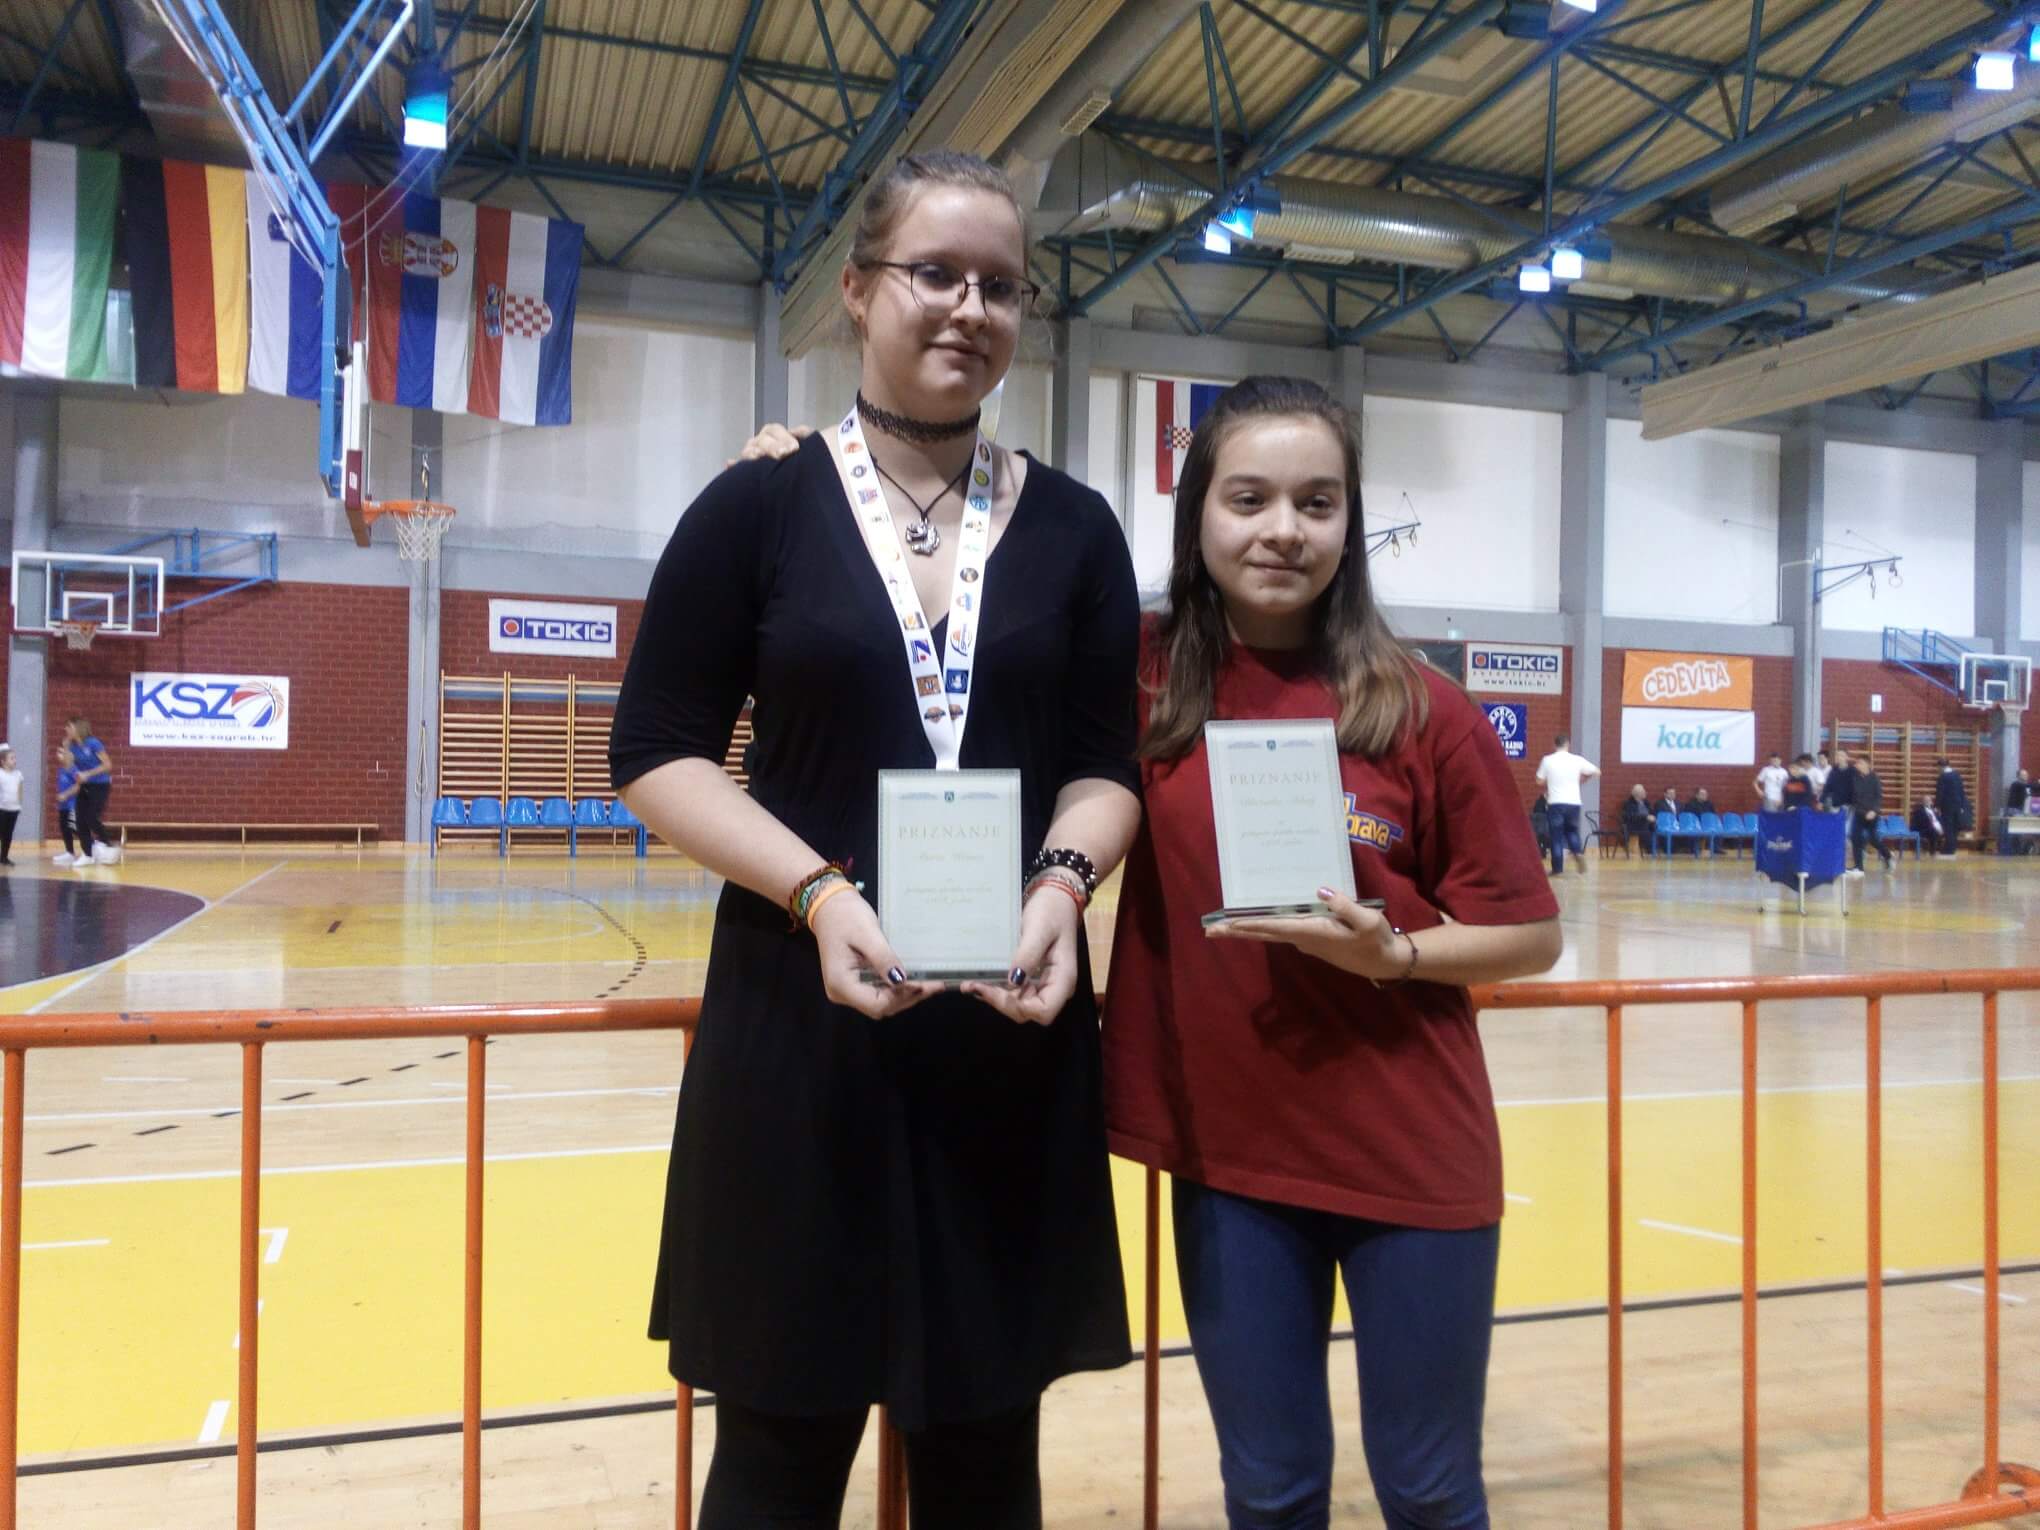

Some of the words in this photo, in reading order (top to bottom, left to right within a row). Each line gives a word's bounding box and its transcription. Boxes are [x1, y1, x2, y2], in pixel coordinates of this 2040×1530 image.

[526, 621, 609, 641] TOKIĆ
[1492, 654, 1556, 671] TOKIĆ
[1644, 661, 1730, 698] CEDEVITA
[135, 679, 241, 720] KSZ
[1656, 724, 1722, 750] kala
[898, 825, 1000, 840] PRIZNANJE
